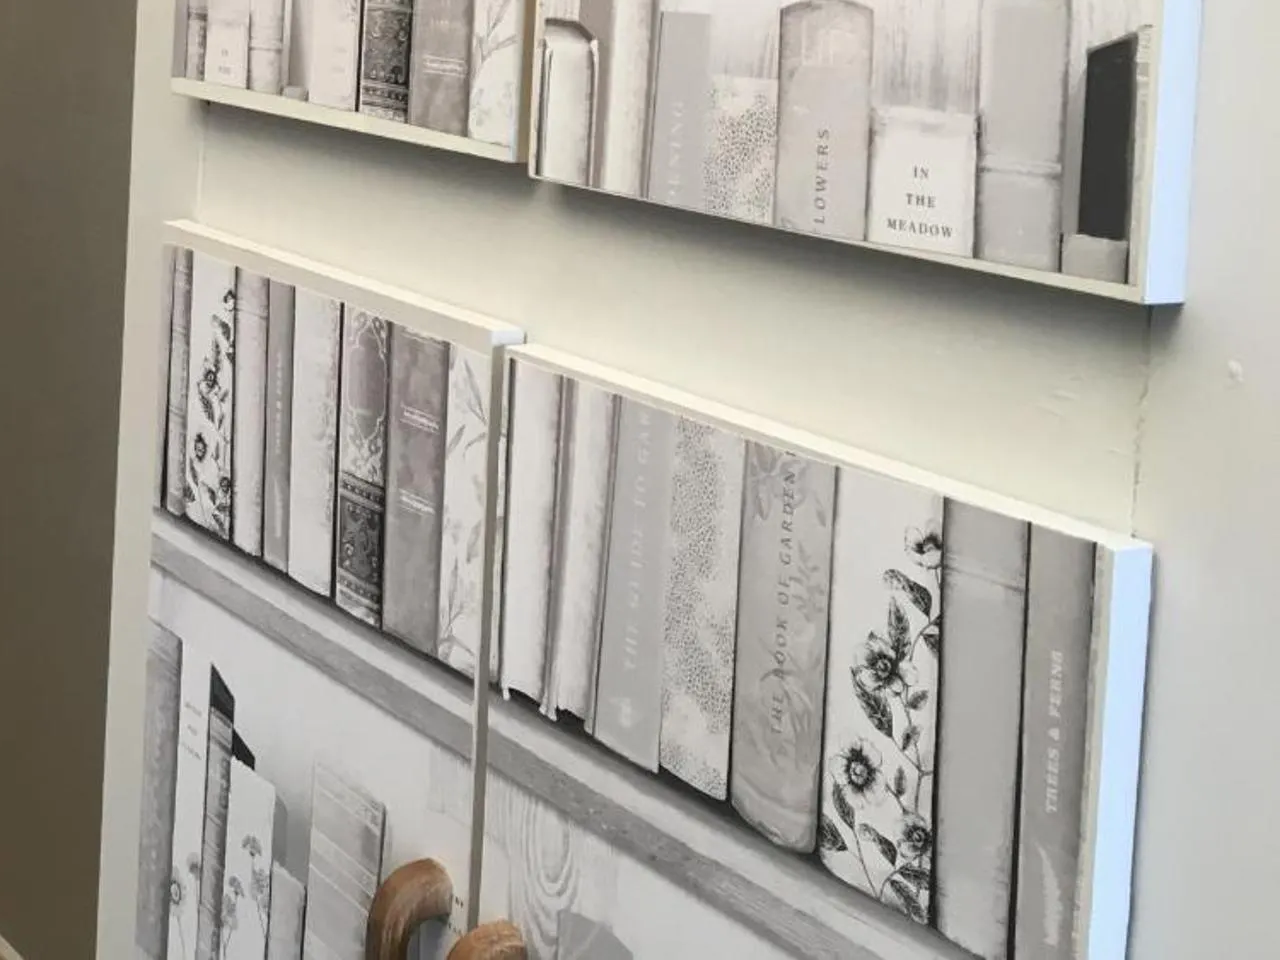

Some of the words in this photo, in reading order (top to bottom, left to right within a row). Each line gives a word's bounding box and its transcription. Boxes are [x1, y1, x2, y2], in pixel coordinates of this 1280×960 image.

[913, 164, 929, 178] IN
[906, 193, 936, 208] THE
[886, 218, 953, 238] MEADOW
[777, 579, 790, 607] OF
[773, 618, 789, 681] BOOK
[770, 693, 785, 734] THE
